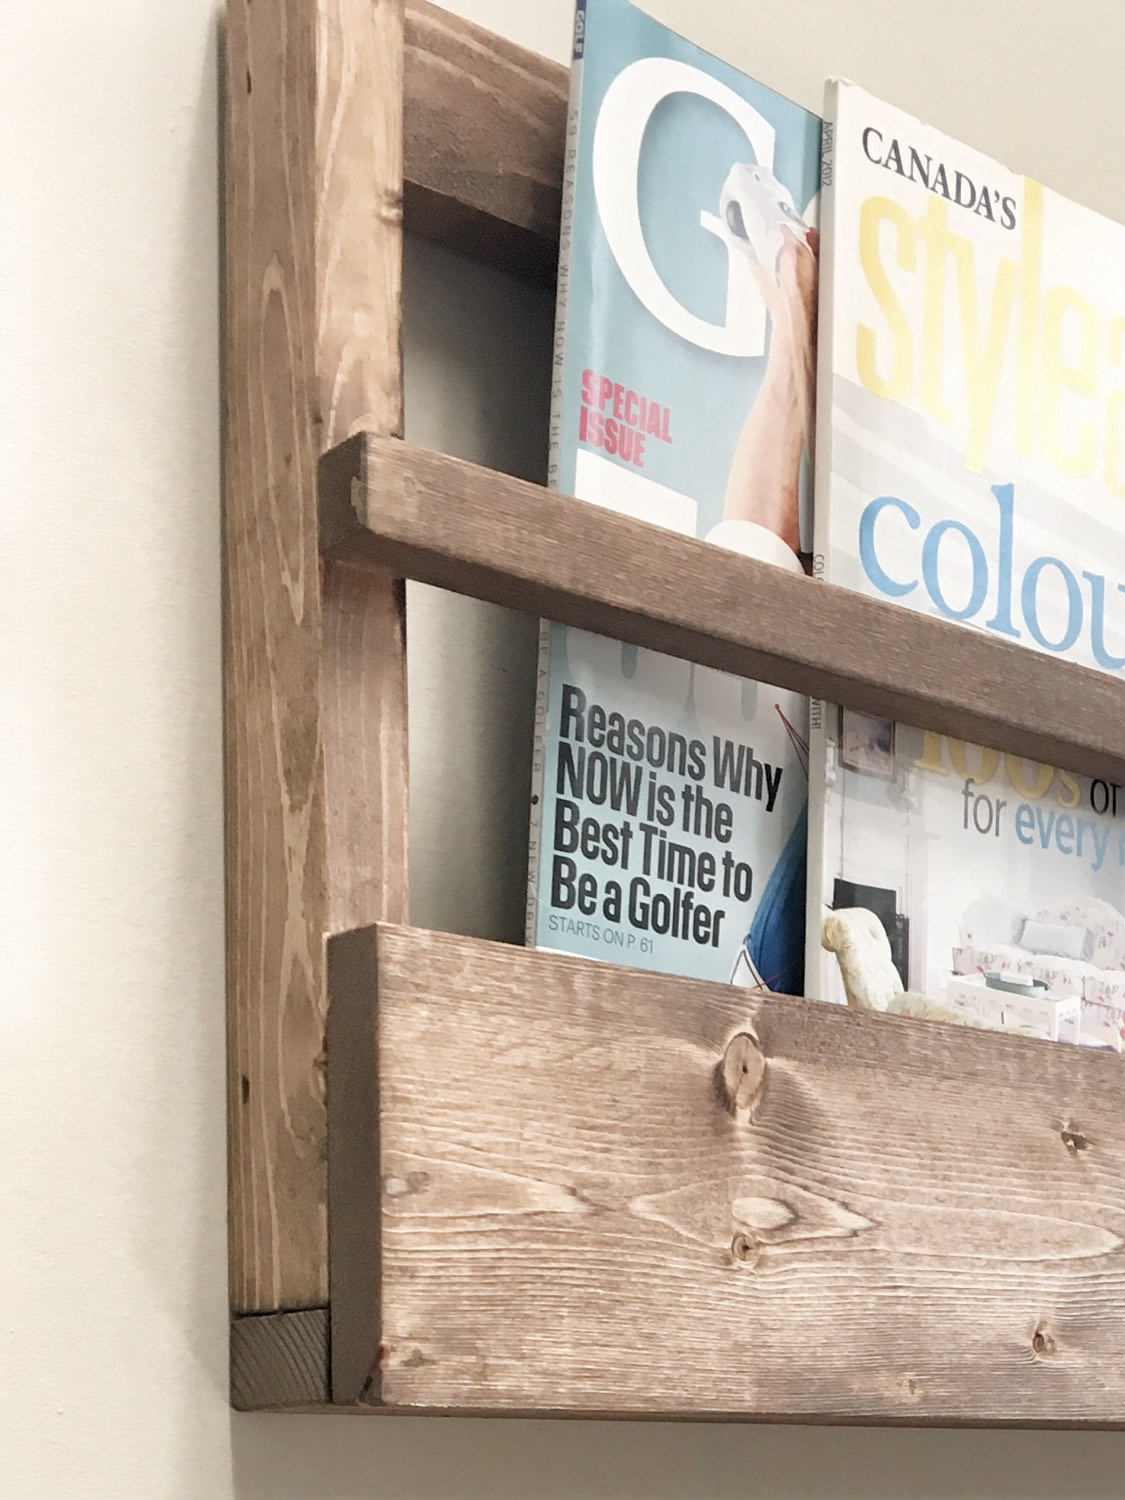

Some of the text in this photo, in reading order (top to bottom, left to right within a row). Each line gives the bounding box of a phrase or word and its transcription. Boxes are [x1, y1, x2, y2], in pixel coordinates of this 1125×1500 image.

[861, 127, 1017, 230] CANADA'S
[579, 406, 646, 468] ISSUE
[581, 368, 674, 444] SPECIAL
[557, 741, 733, 843] NOW is the
[559, 684, 783, 813] Reasons Why
[554, 798, 753, 902] Best Time to
[962, 777, 1007, 837] for
[1015, 803, 1108, 872] every
[549, 915, 654, 954] STARTS ON P. 61
[550, 855, 726, 948] Be a Golfer
